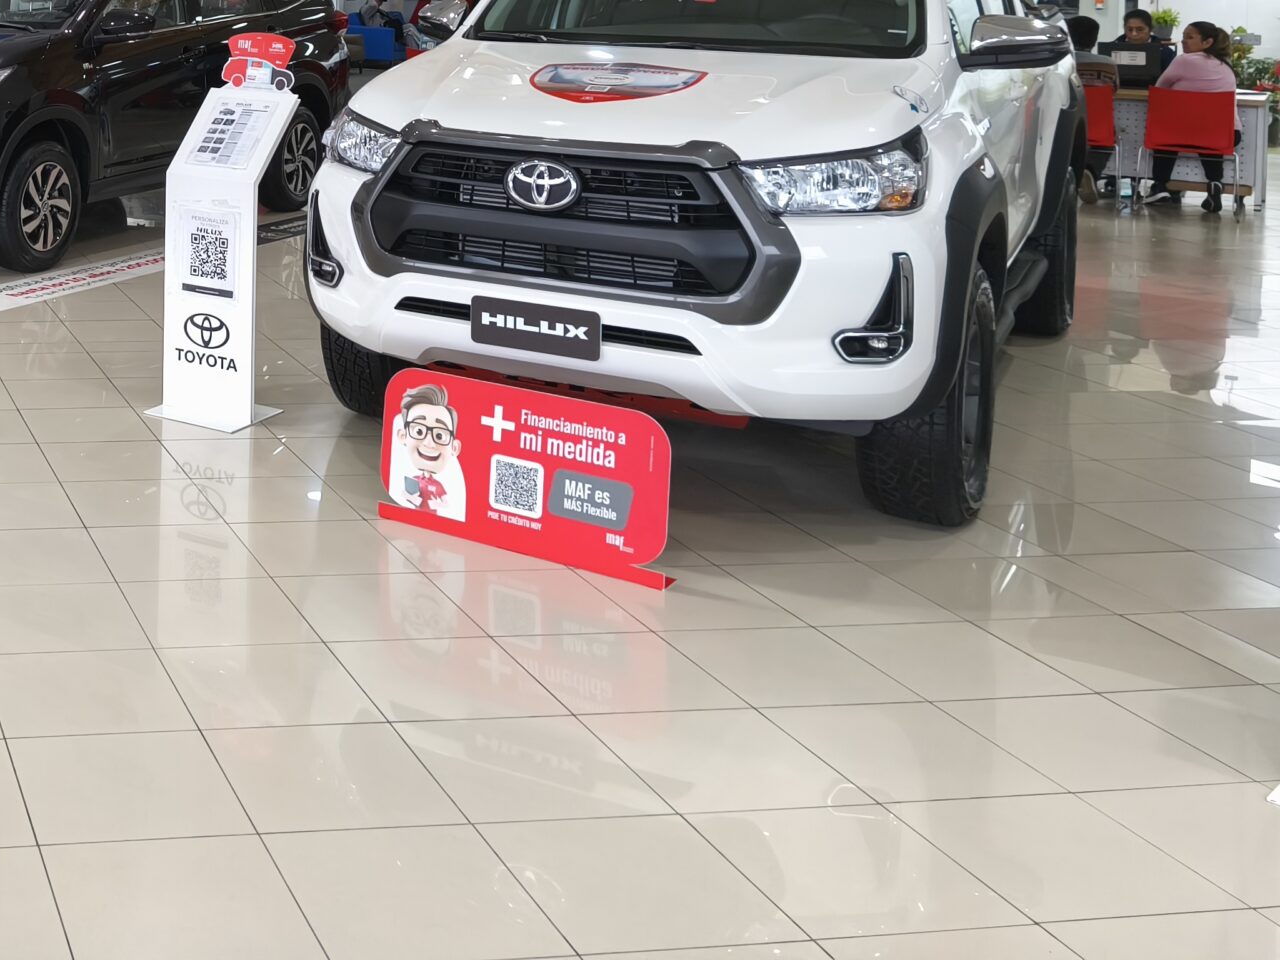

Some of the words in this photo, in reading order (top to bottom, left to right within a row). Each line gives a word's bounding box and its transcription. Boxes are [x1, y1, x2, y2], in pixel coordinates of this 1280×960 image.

[191, 215, 229, 225] PERSONALIZA
[196, 226, 223, 237] HILUX
[481, 311, 589, 341] HILUX
[174, 347, 238, 373] TOYOTA
[520, 409, 615, 443] Financiamiento
[617, 432, 626, 446] a
[520, 430, 543, 453] mi
[546, 437, 616, 469] medida
[564, 478, 593, 501] MAF
[594, 489, 611, 505] es
[487, 510, 500, 522] PIDE
[500, 513, 508, 522] TU
[508, 513, 531, 527] CRÉDITO
[530, 521, 542, 531] HOY
[563, 497, 582, 512] MÁS
[582, 503, 617, 521] Flexible
[605, 532, 625, 551] maf
